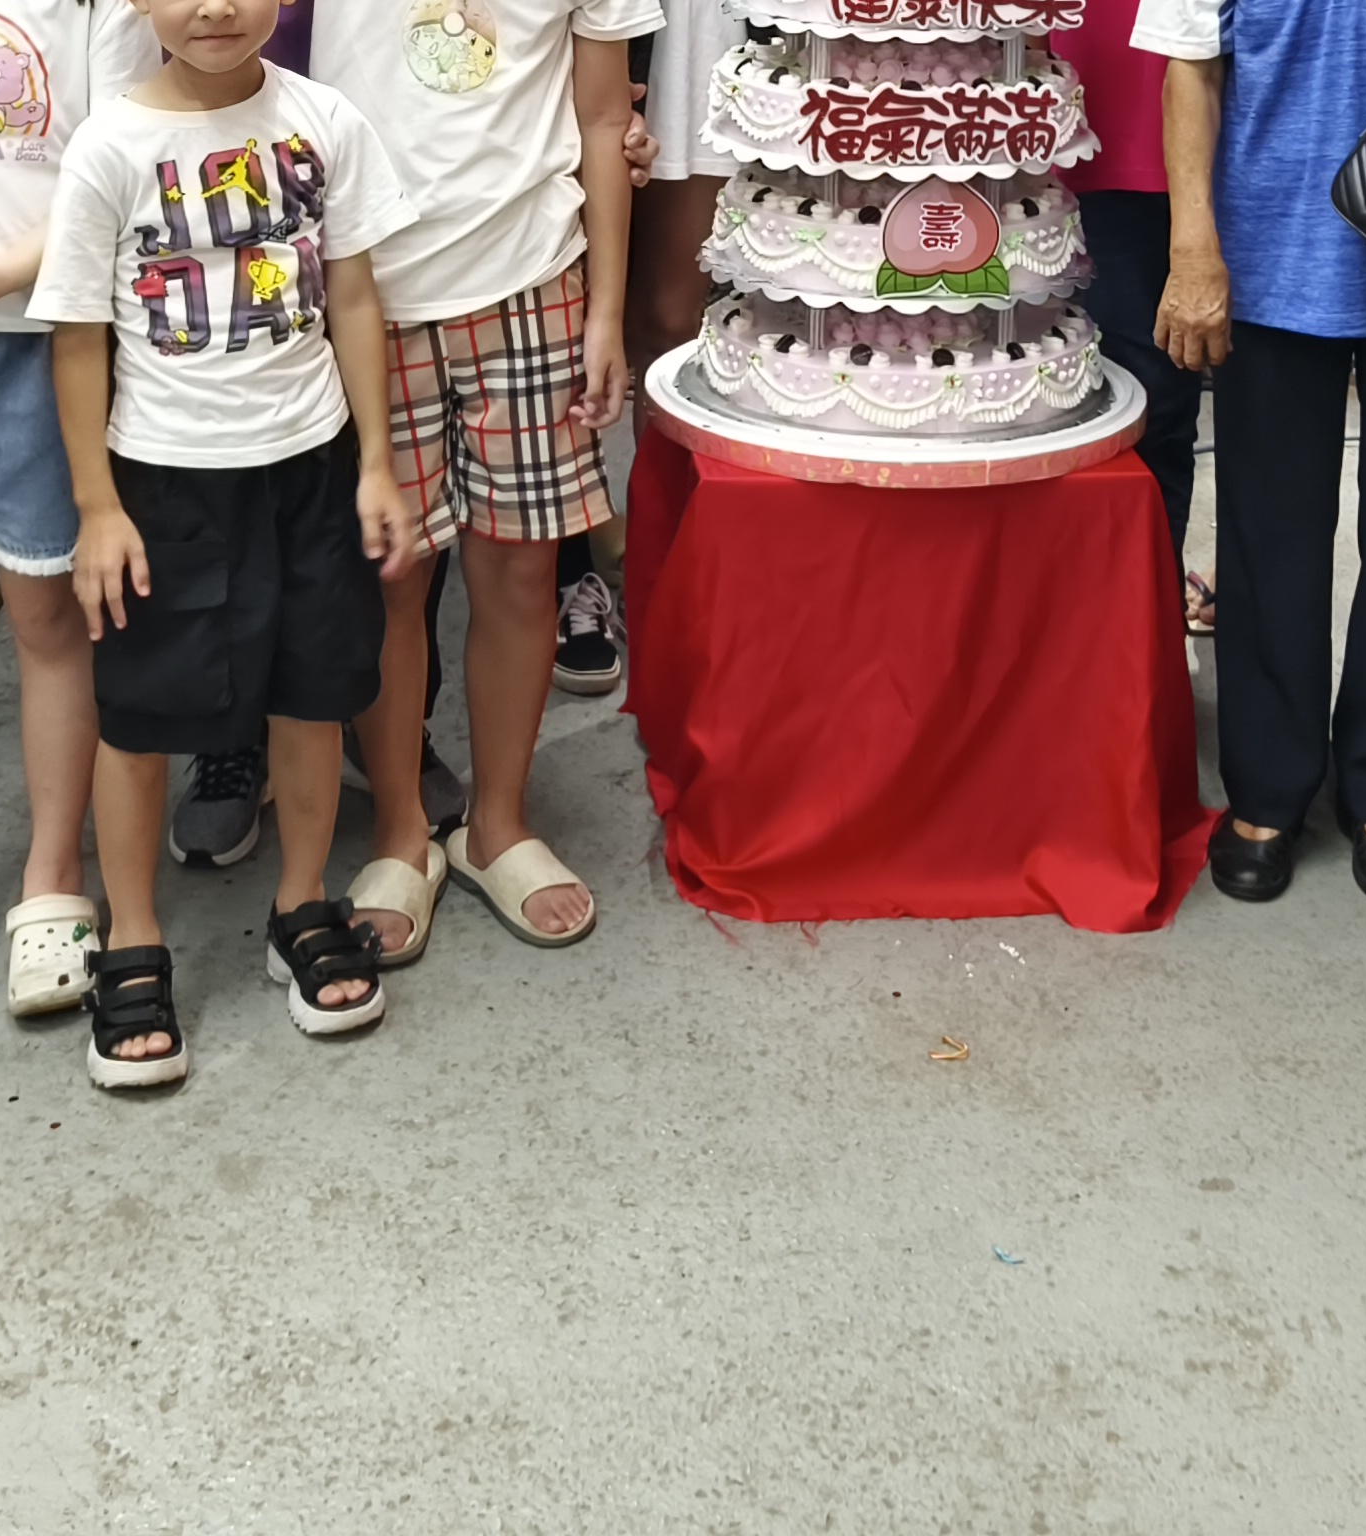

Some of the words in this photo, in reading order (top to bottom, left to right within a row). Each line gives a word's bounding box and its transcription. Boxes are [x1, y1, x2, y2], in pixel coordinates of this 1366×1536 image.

[798, 86, 1058, 164] 福氣滿滿
[920, 203, 965, 251] 壽
